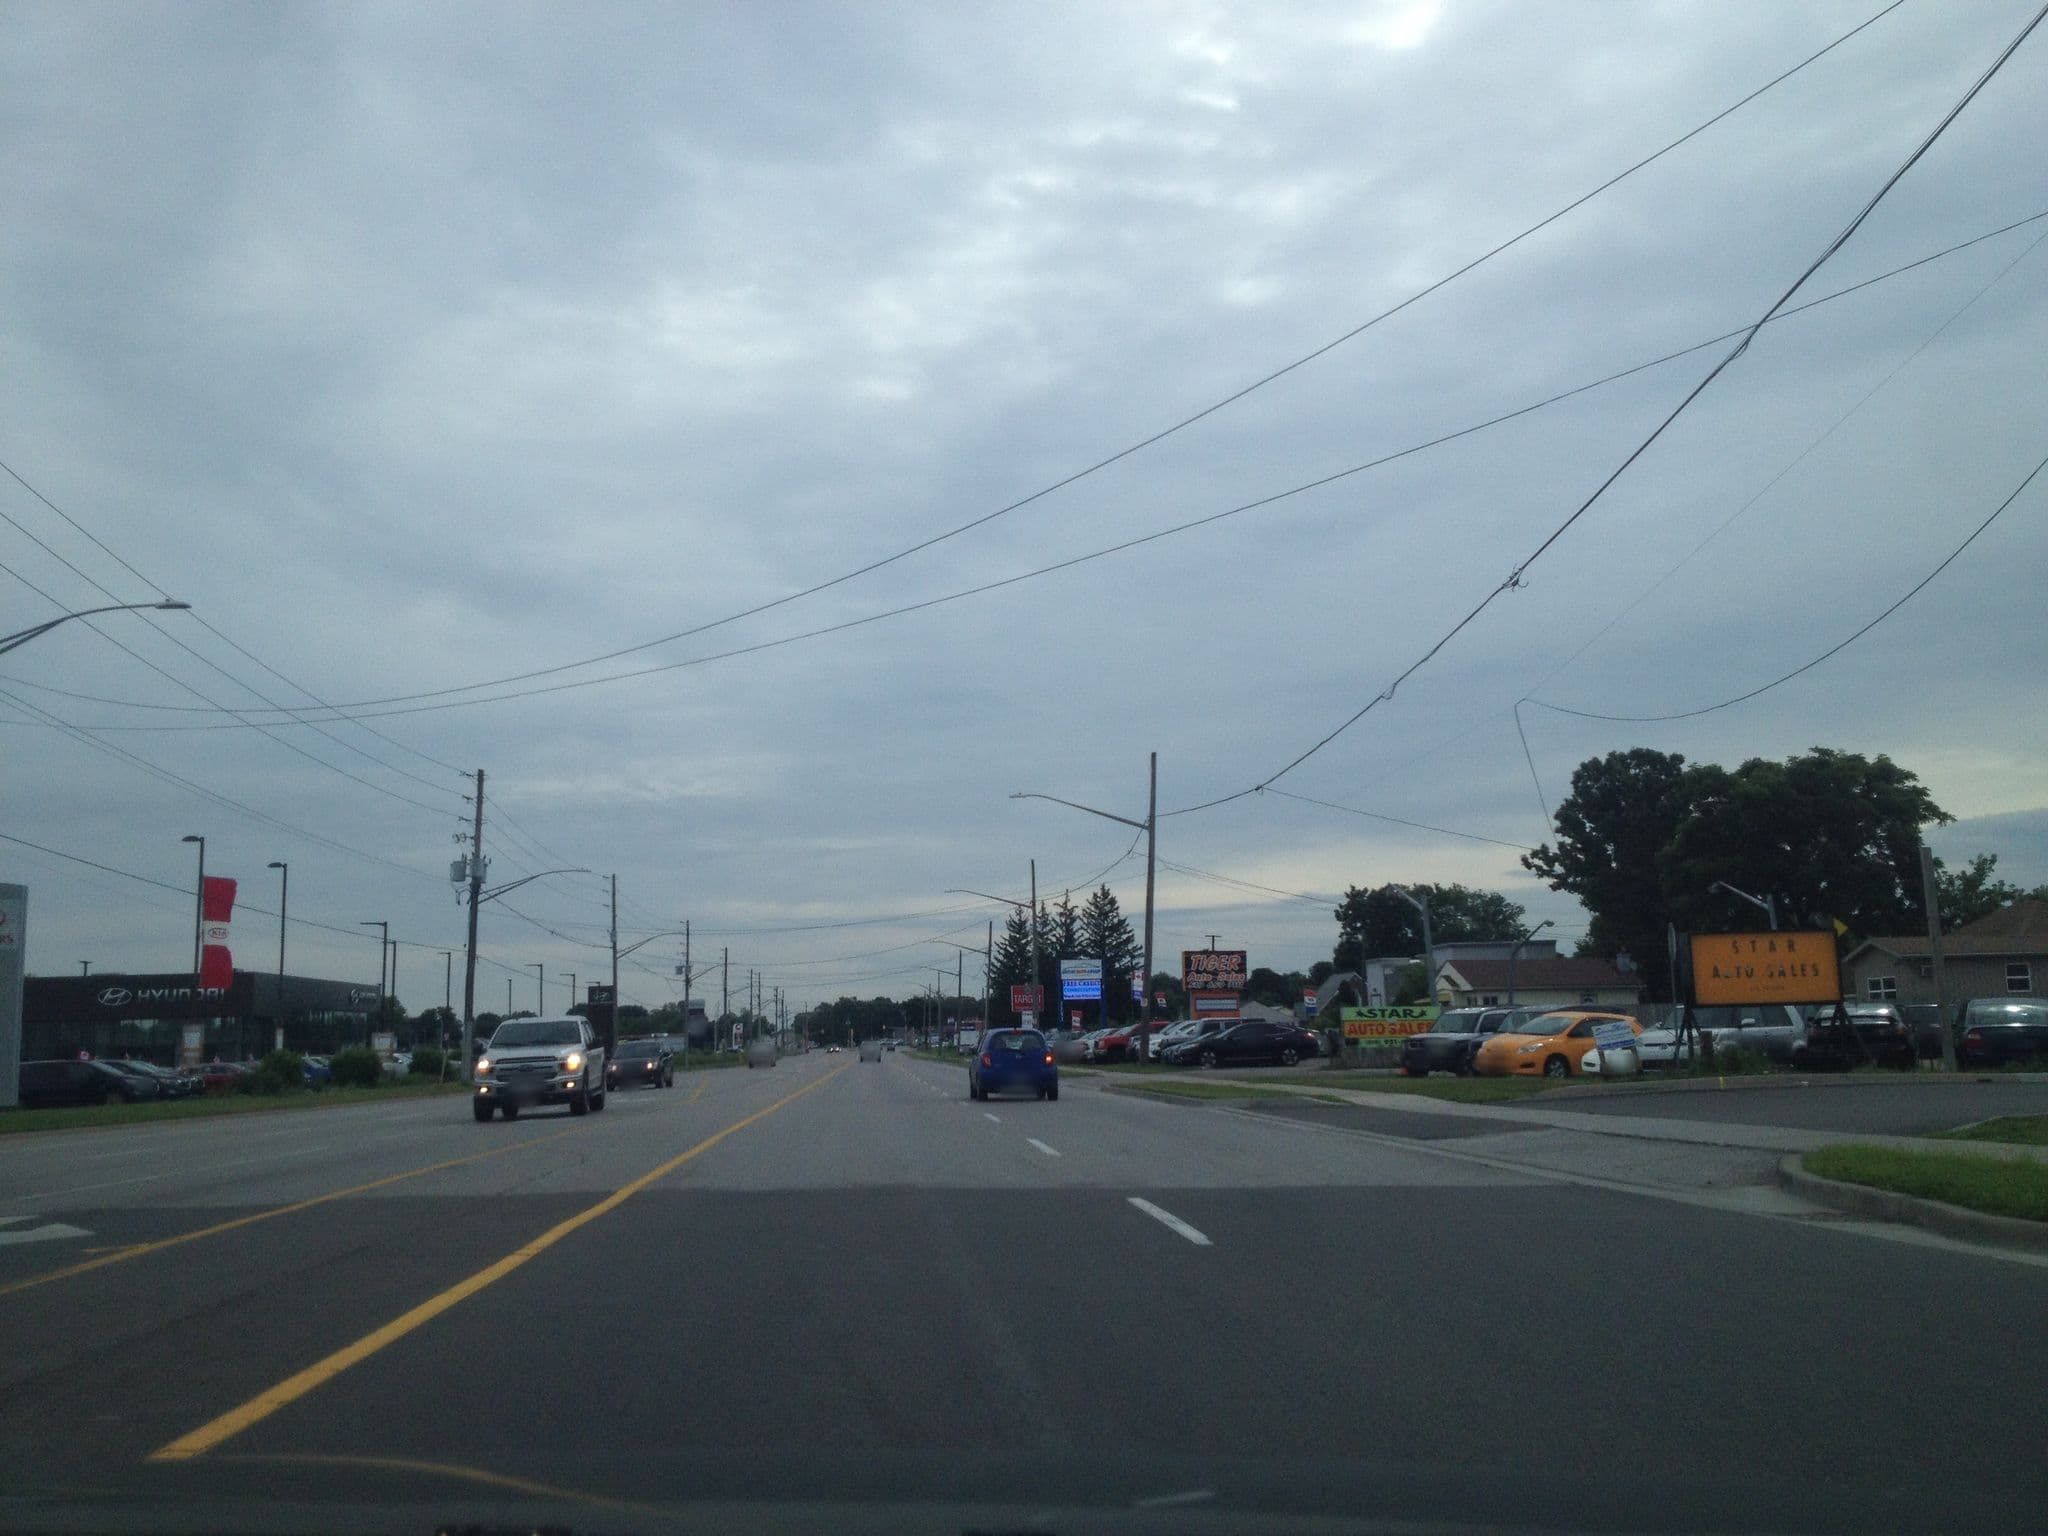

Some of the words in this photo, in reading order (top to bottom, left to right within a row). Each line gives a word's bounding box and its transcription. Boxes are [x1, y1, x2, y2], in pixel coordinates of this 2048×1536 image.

[1731, 939, 1797, 953] STAR
[1191, 954, 1241, 970] TIGER
[1365, 1008, 1415, 1018] STAR
[1348, 1023, 1385, 1035] AUTO
